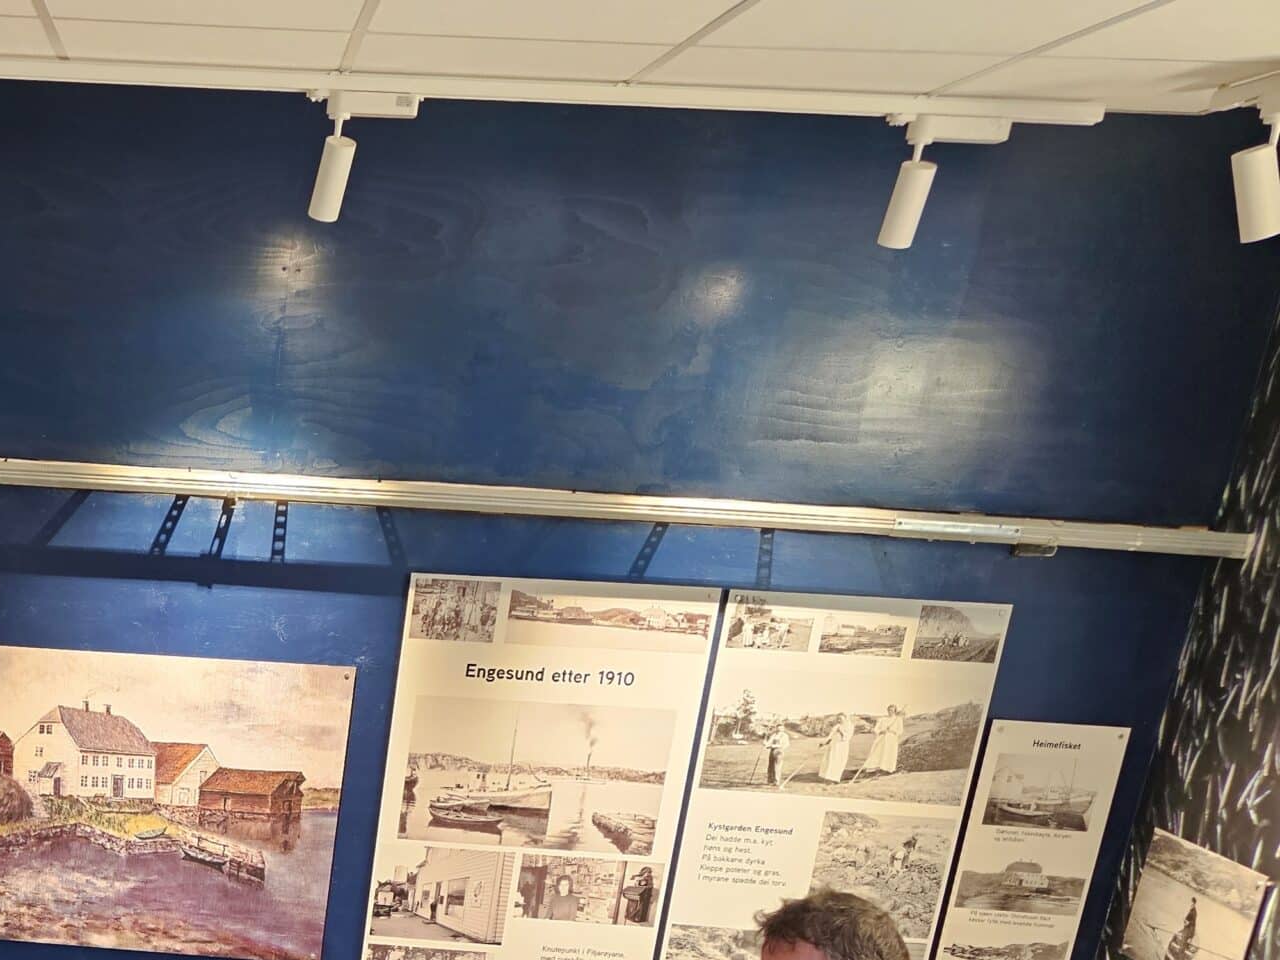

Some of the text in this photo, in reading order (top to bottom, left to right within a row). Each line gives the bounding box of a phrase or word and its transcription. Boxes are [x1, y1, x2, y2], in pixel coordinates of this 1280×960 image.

[465, 663, 635, 686] Engesund etter 1910
[1032, 739, 1082, 750] Heimefisket
[708, 822, 794, 835] Kystgarden Engesund
